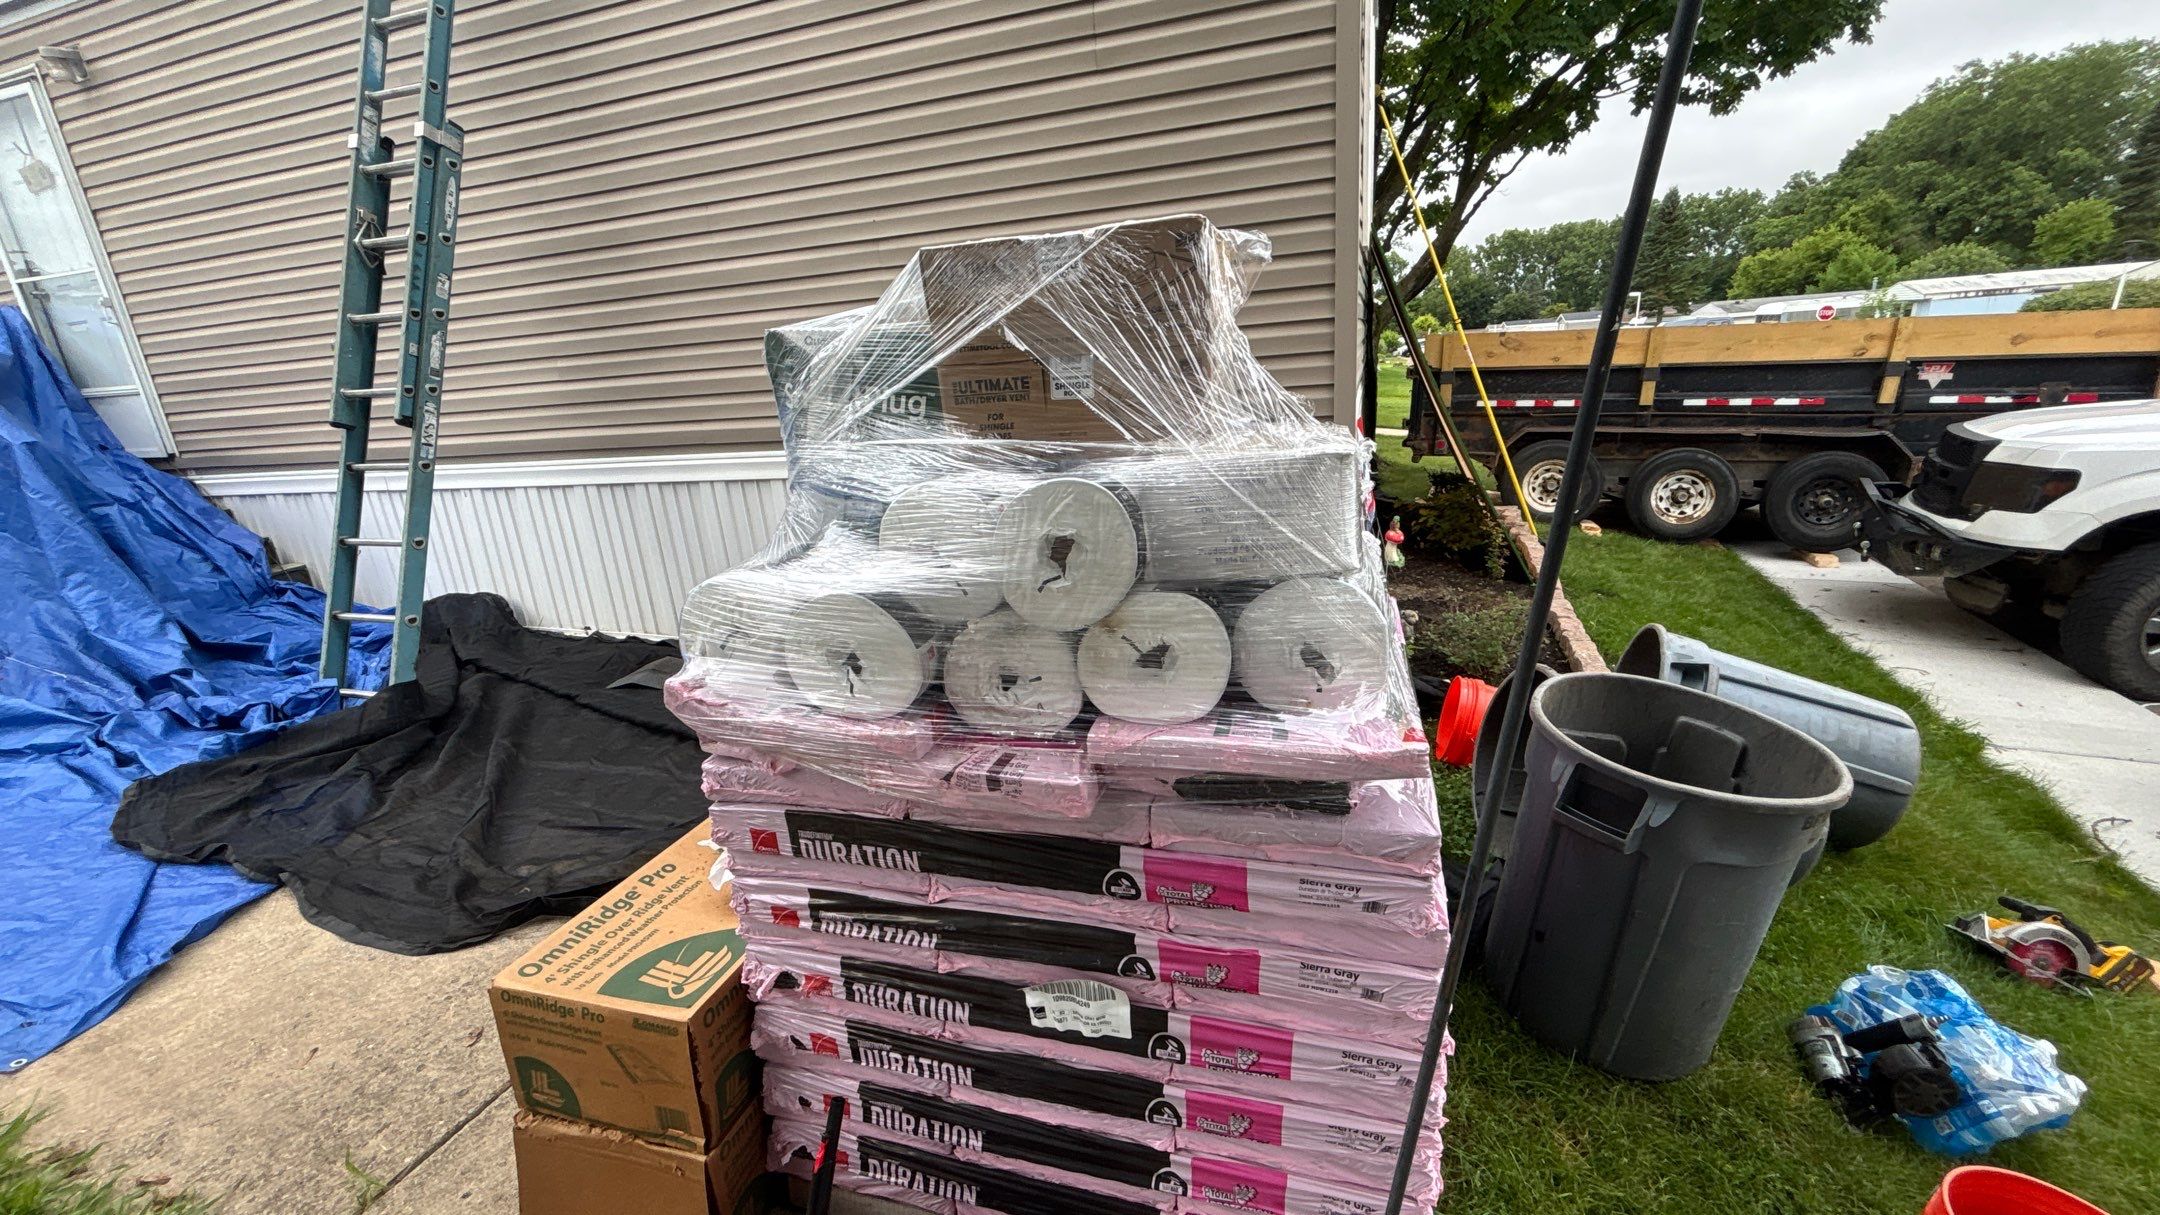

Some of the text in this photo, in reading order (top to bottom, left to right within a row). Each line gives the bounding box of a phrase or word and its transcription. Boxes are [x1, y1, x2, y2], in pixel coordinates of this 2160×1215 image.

[1819, 309, 1834, 317] STOP
[958, 376, 1030, 394] ULTIMATE
[955, 393, 1031, 405] BATH/DRYER VENT
[979, 422, 1014, 432] SHINGLE
[988, 413, 1004, 421] FOR
[798, 839, 921, 872] DURATION
[1299, 878, 1362, 894] Sierra Gray
[517, 861, 677, 978] OmniRidge Pro
[559, 943, 602, 976] Shingle
[604, 916, 636, 940] Over
[635, 894, 667, 920] Ridge
[661, 875, 690, 896] Vent
[560, 879, 703, 988] with Enhanced Weather Protection
[1300, 962, 1331, 974] Sierra
[1334, 968, 1360, 982] Gray
[500, 989, 606, 1025] OmniRidge Pro
[852, 982, 970, 1025] DURATION
[858, 1047, 972, 1088] DURATION
[1211, 1056, 1234, 1065] TOTAL
[1341, 1051, 1403, 1073] Sierra Gray
[871, 1105, 983, 1152] DURATION
[1362, 1130, 1386, 1143] Gray
[868, 1158, 977, 1206] DURATION
[1210, 1189, 1236, 1202] TOTAL
